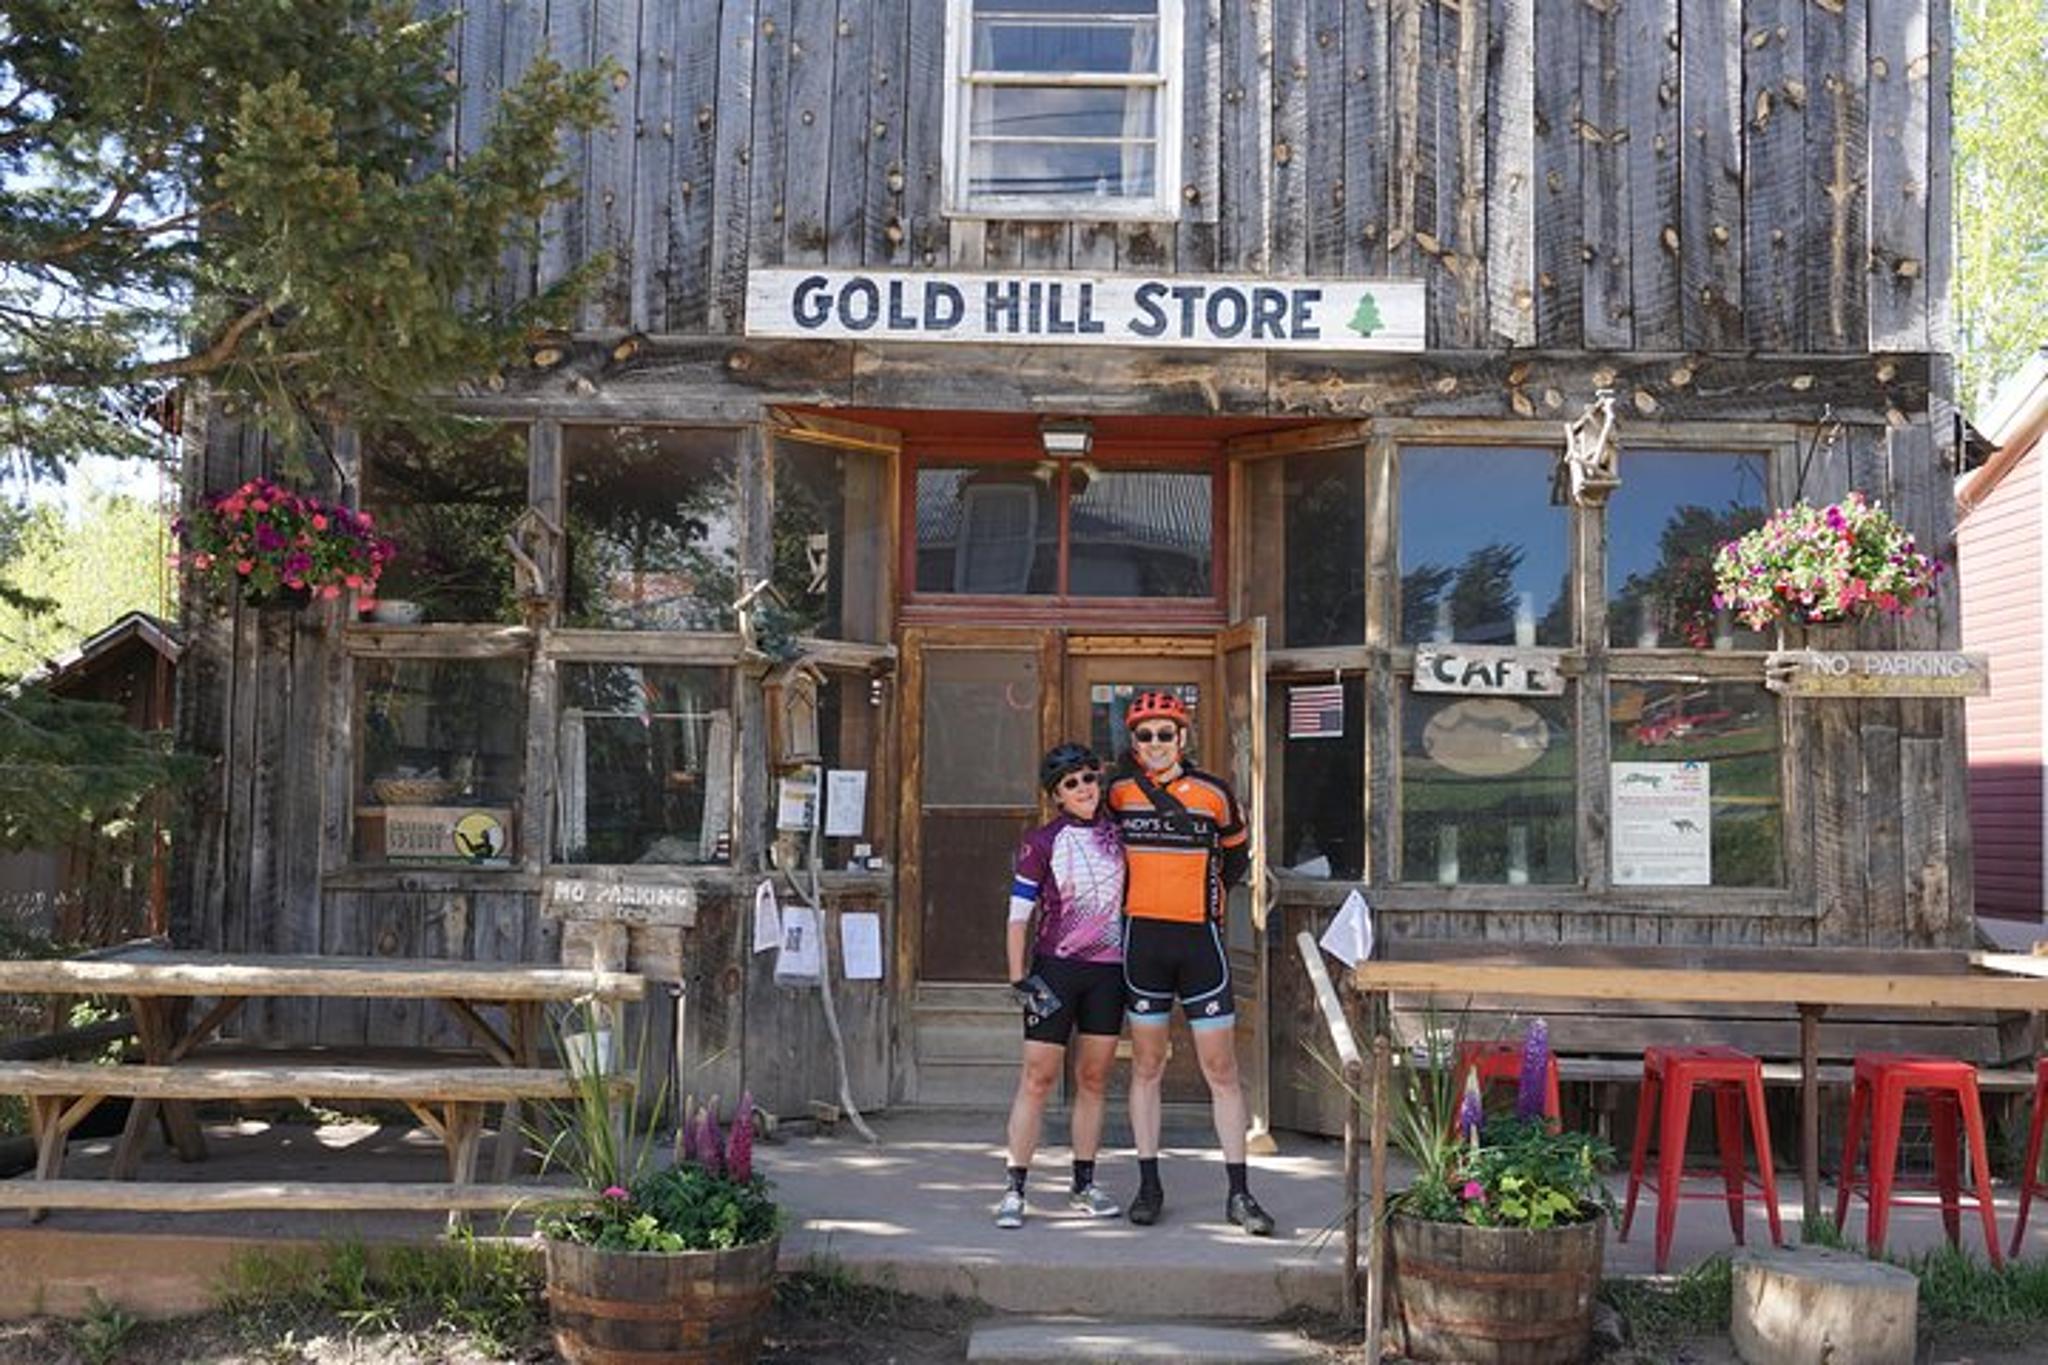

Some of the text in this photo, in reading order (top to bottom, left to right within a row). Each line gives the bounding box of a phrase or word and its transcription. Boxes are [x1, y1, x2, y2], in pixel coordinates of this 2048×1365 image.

[792, 275, 1323, 341] GOLD HILL STORE
[1430, 654, 1548, 691] CAFE
[1810, 654, 1970, 678] NO PARKING
[553, 880, 689, 907] NO PARKING
